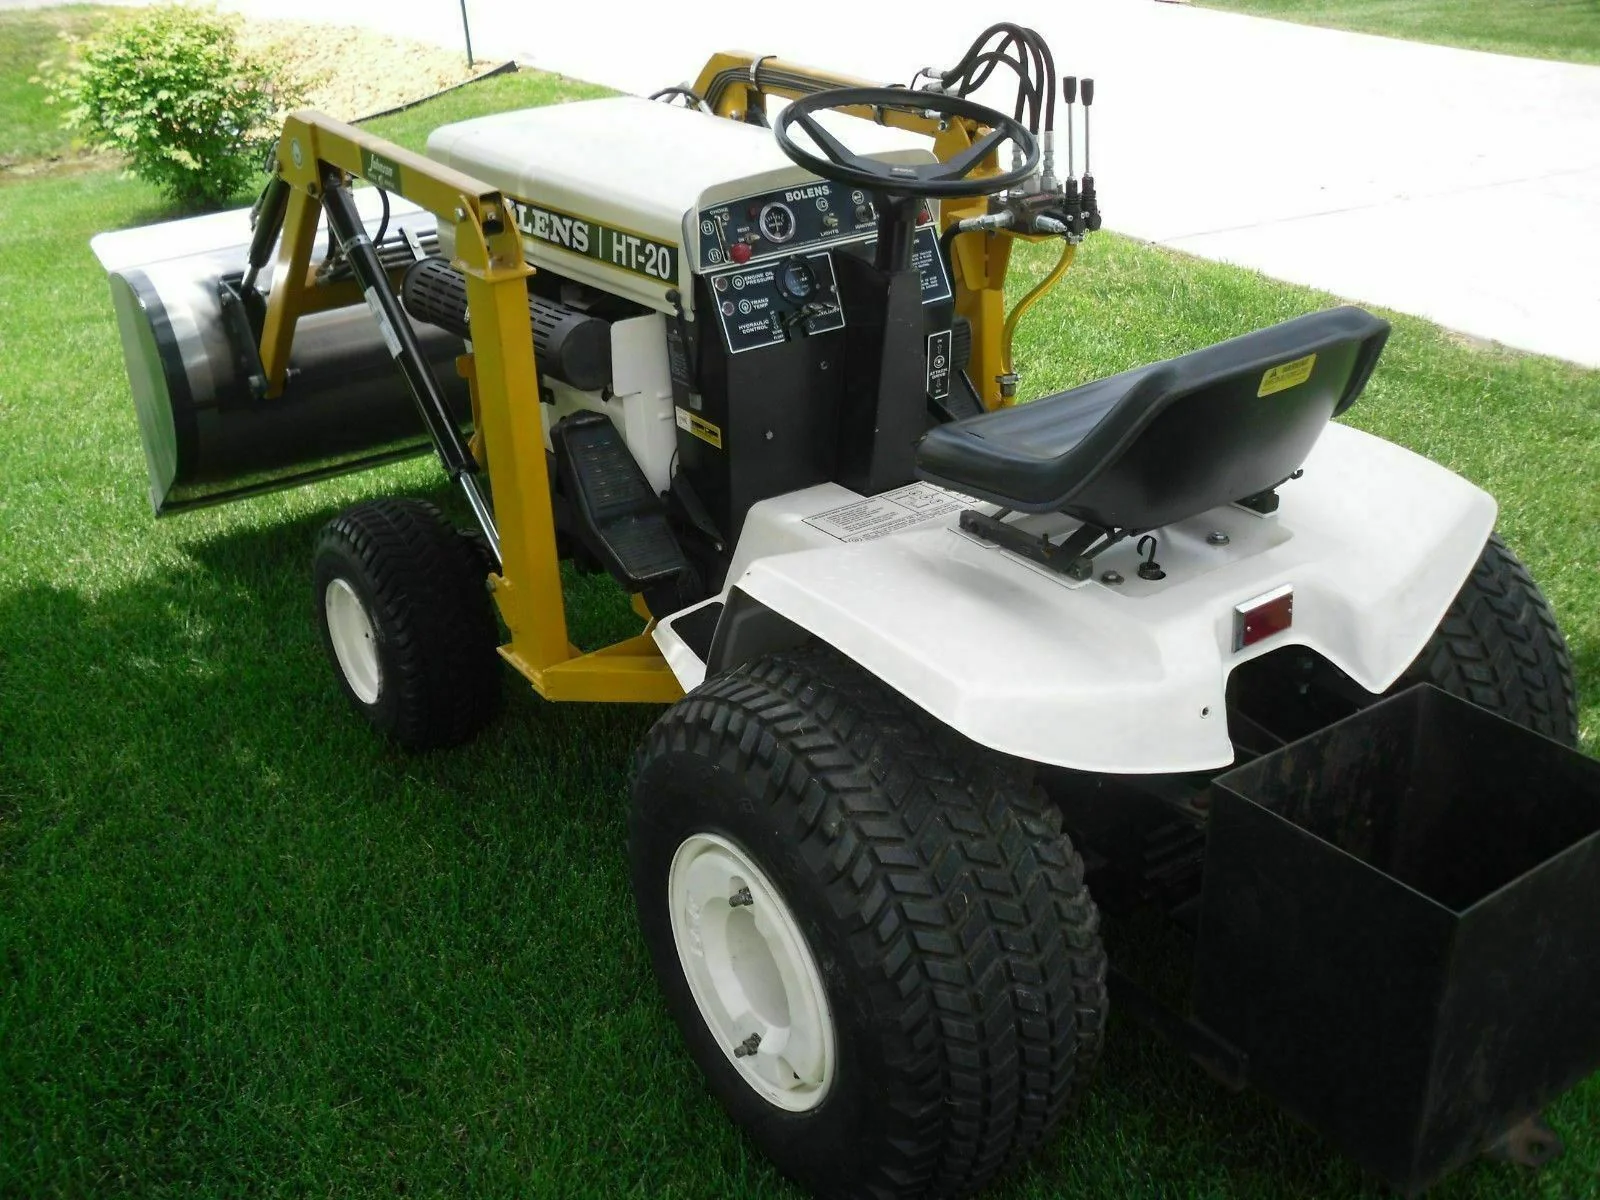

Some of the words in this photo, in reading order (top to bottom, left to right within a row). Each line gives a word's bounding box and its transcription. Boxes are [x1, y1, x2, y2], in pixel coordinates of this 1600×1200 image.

[785, 185, 830, 202] BOLENS
[820, 229, 839, 237] LIGHTS
[612, 231, 670, 280] HT-20
[744, 274, 764, 282] ENGINE
[745, 275, 775, 285] PRESSURE
[738, 320, 770, 330] HYDRAULIC
[742, 325, 768, 335] CONTROL
